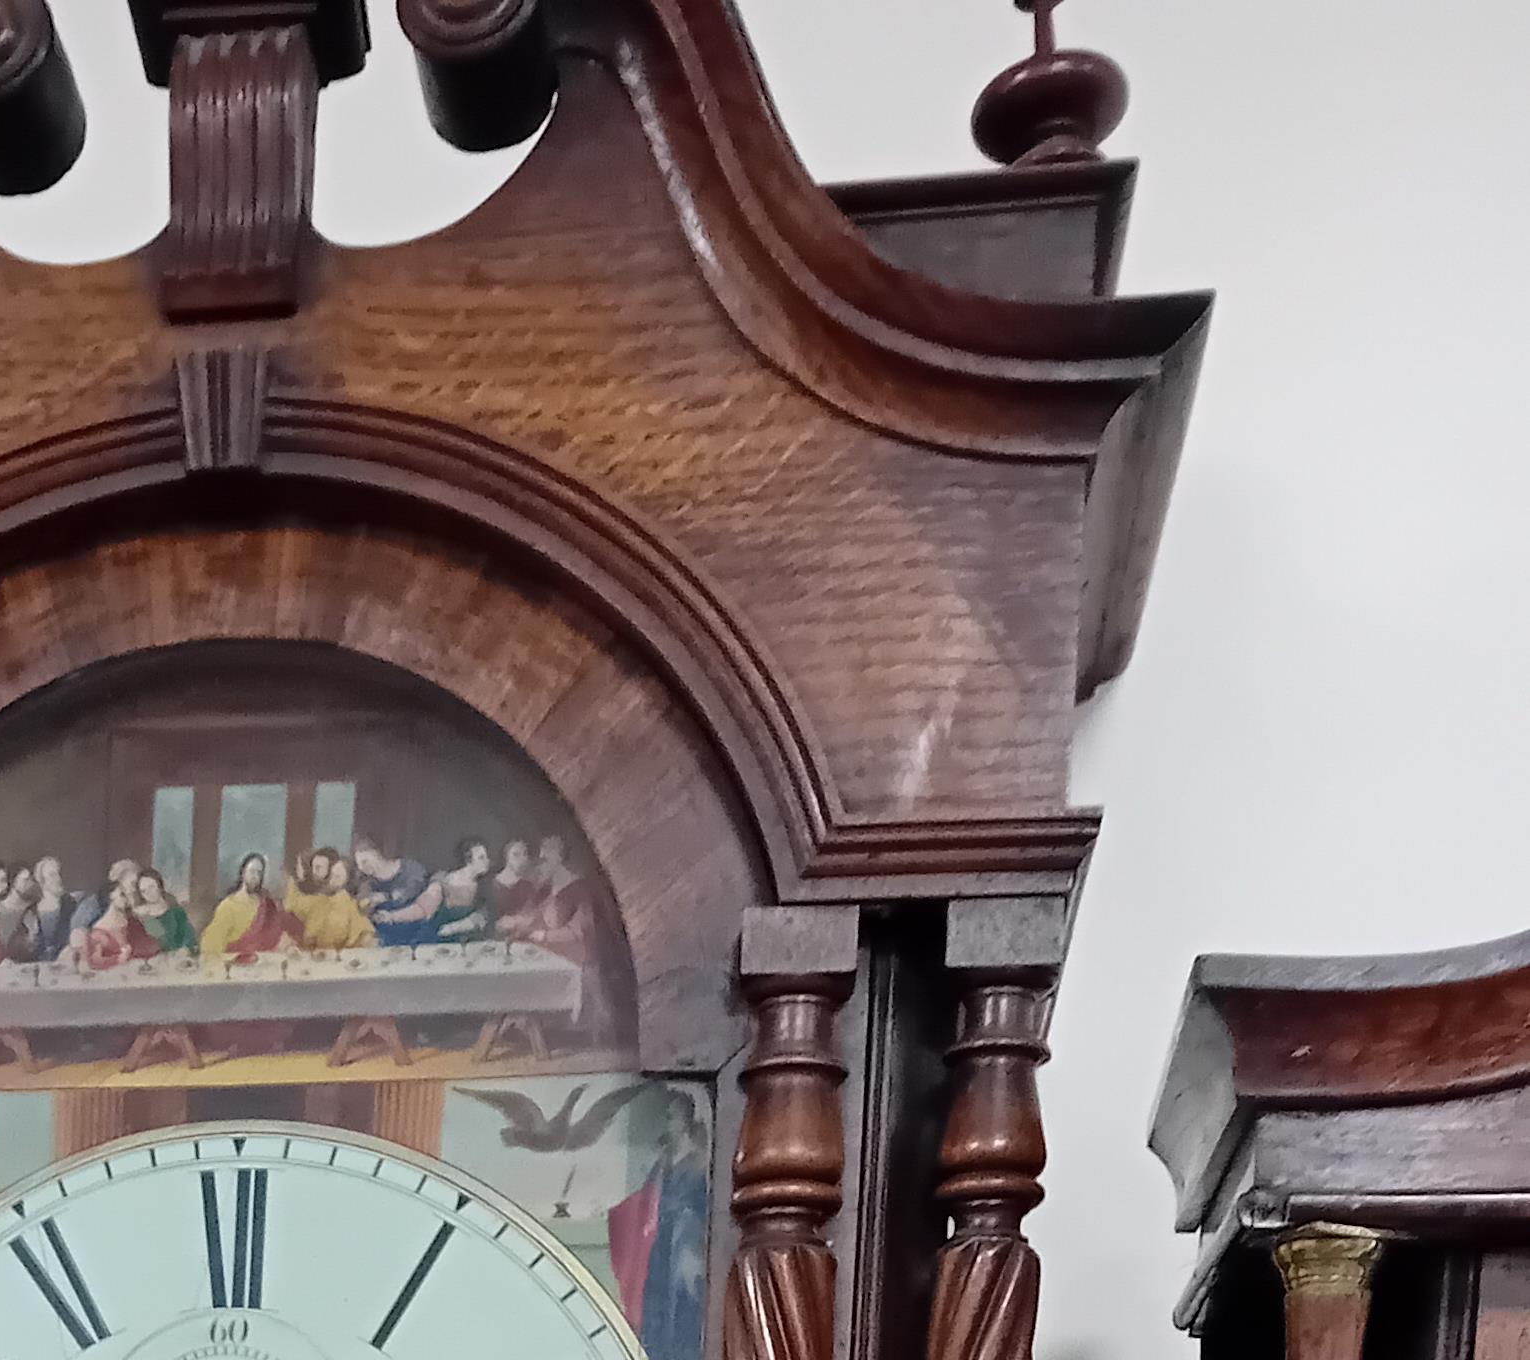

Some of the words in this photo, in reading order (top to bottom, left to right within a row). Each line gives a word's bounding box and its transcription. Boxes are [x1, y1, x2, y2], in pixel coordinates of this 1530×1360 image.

[7, 1216, 113, 1352] XI
[200, 1167, 268, 1311] XII
[209, 1318, 249, 1344] 60
